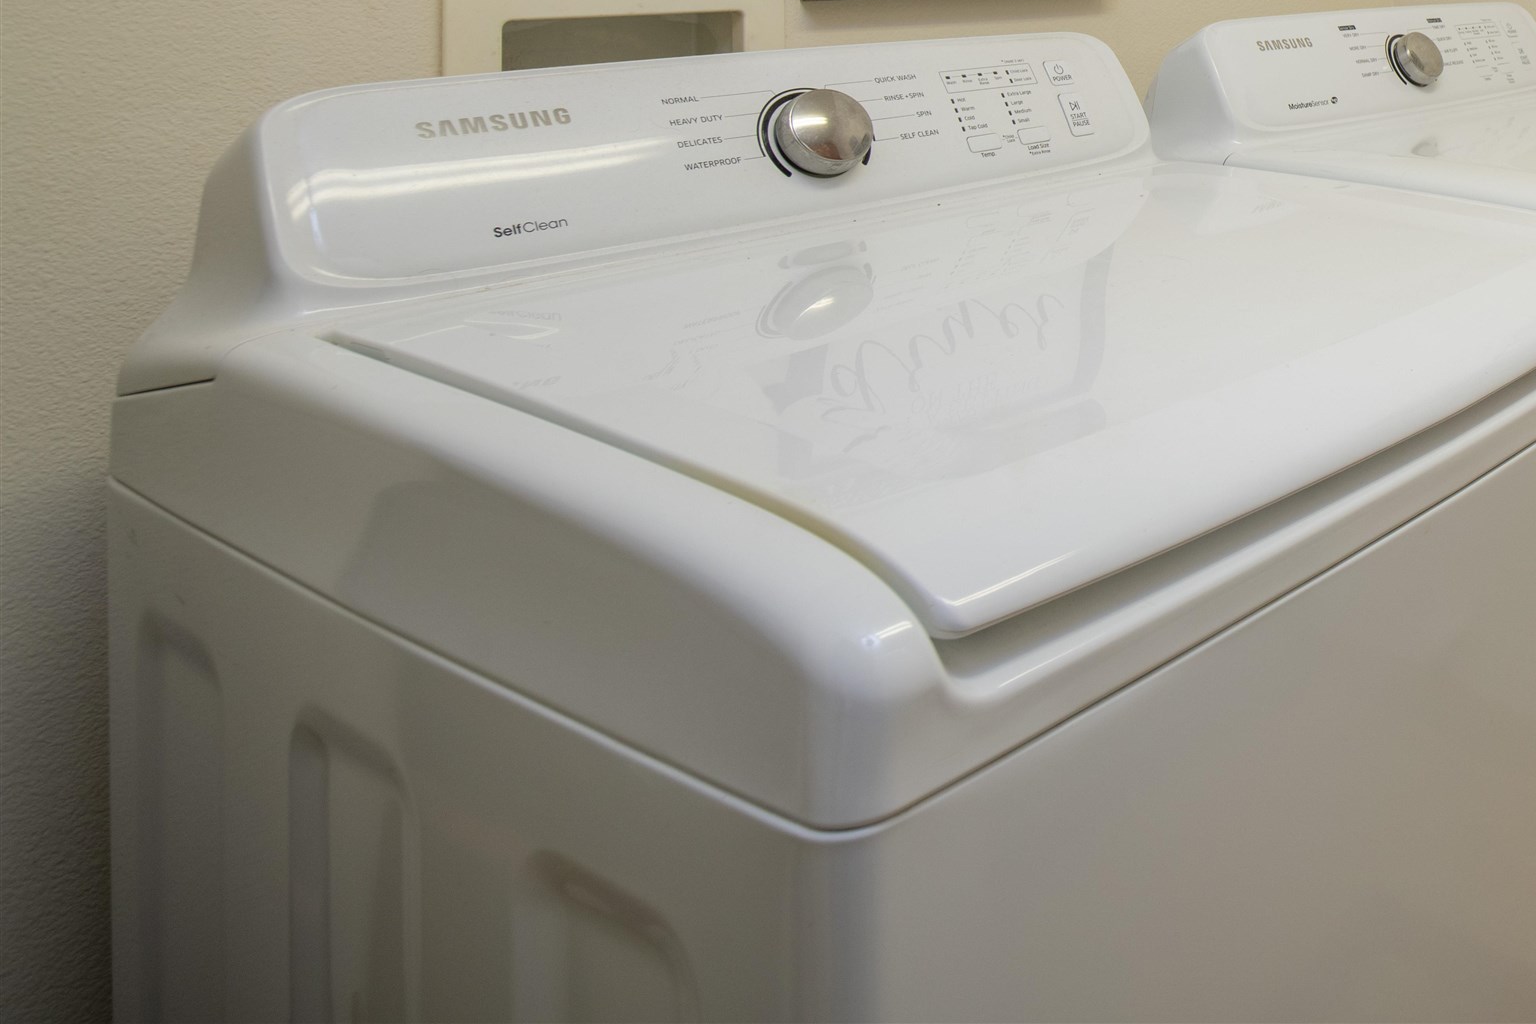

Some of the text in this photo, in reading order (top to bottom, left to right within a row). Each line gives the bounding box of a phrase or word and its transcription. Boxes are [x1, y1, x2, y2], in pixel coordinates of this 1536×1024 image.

[1256, 36, 1313, 52] SAMSUNG
[661, 95, 699, 105] NORMAL
[414, 107, 572, 140] SAMSUNG
[669, 114, 723, 127] HEAVY DUTY
[900, 129, 939, 140] SELF CLEAN
[677, 136, 723, 149] DELICATES
[684, 157, 742, 172] WATERPROOF
[493, 217, 568, 238] SelfClean
